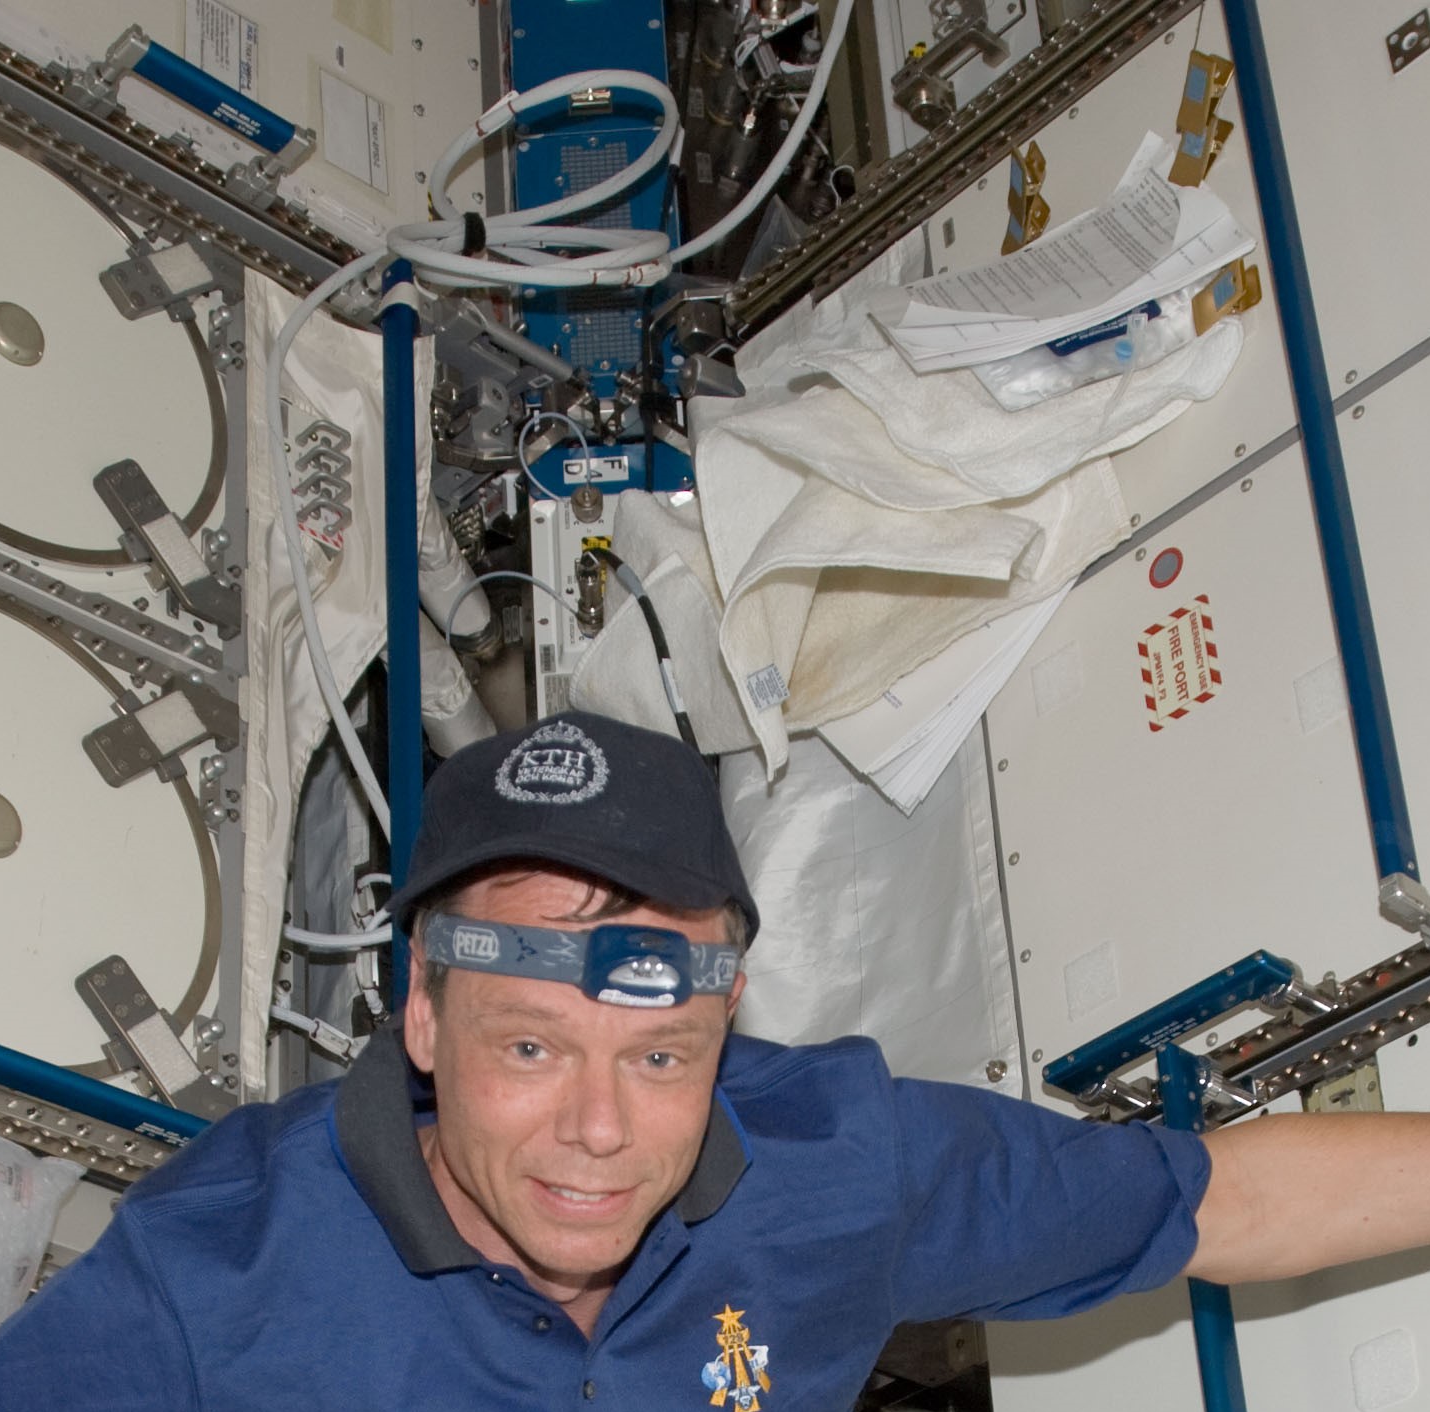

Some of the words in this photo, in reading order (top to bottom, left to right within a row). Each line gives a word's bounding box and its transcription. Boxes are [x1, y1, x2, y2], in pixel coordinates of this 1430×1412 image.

[1167, 625, 1182, 660] FIRE
[1185, 611, 1204, 669] EMERGENCY
[1198, 670, 1207, 691] USE
[1173, 660, 1189, 700] PORT
[523, 750, 587, 768] KTH
[454, 931, 499, 958] PETZL
